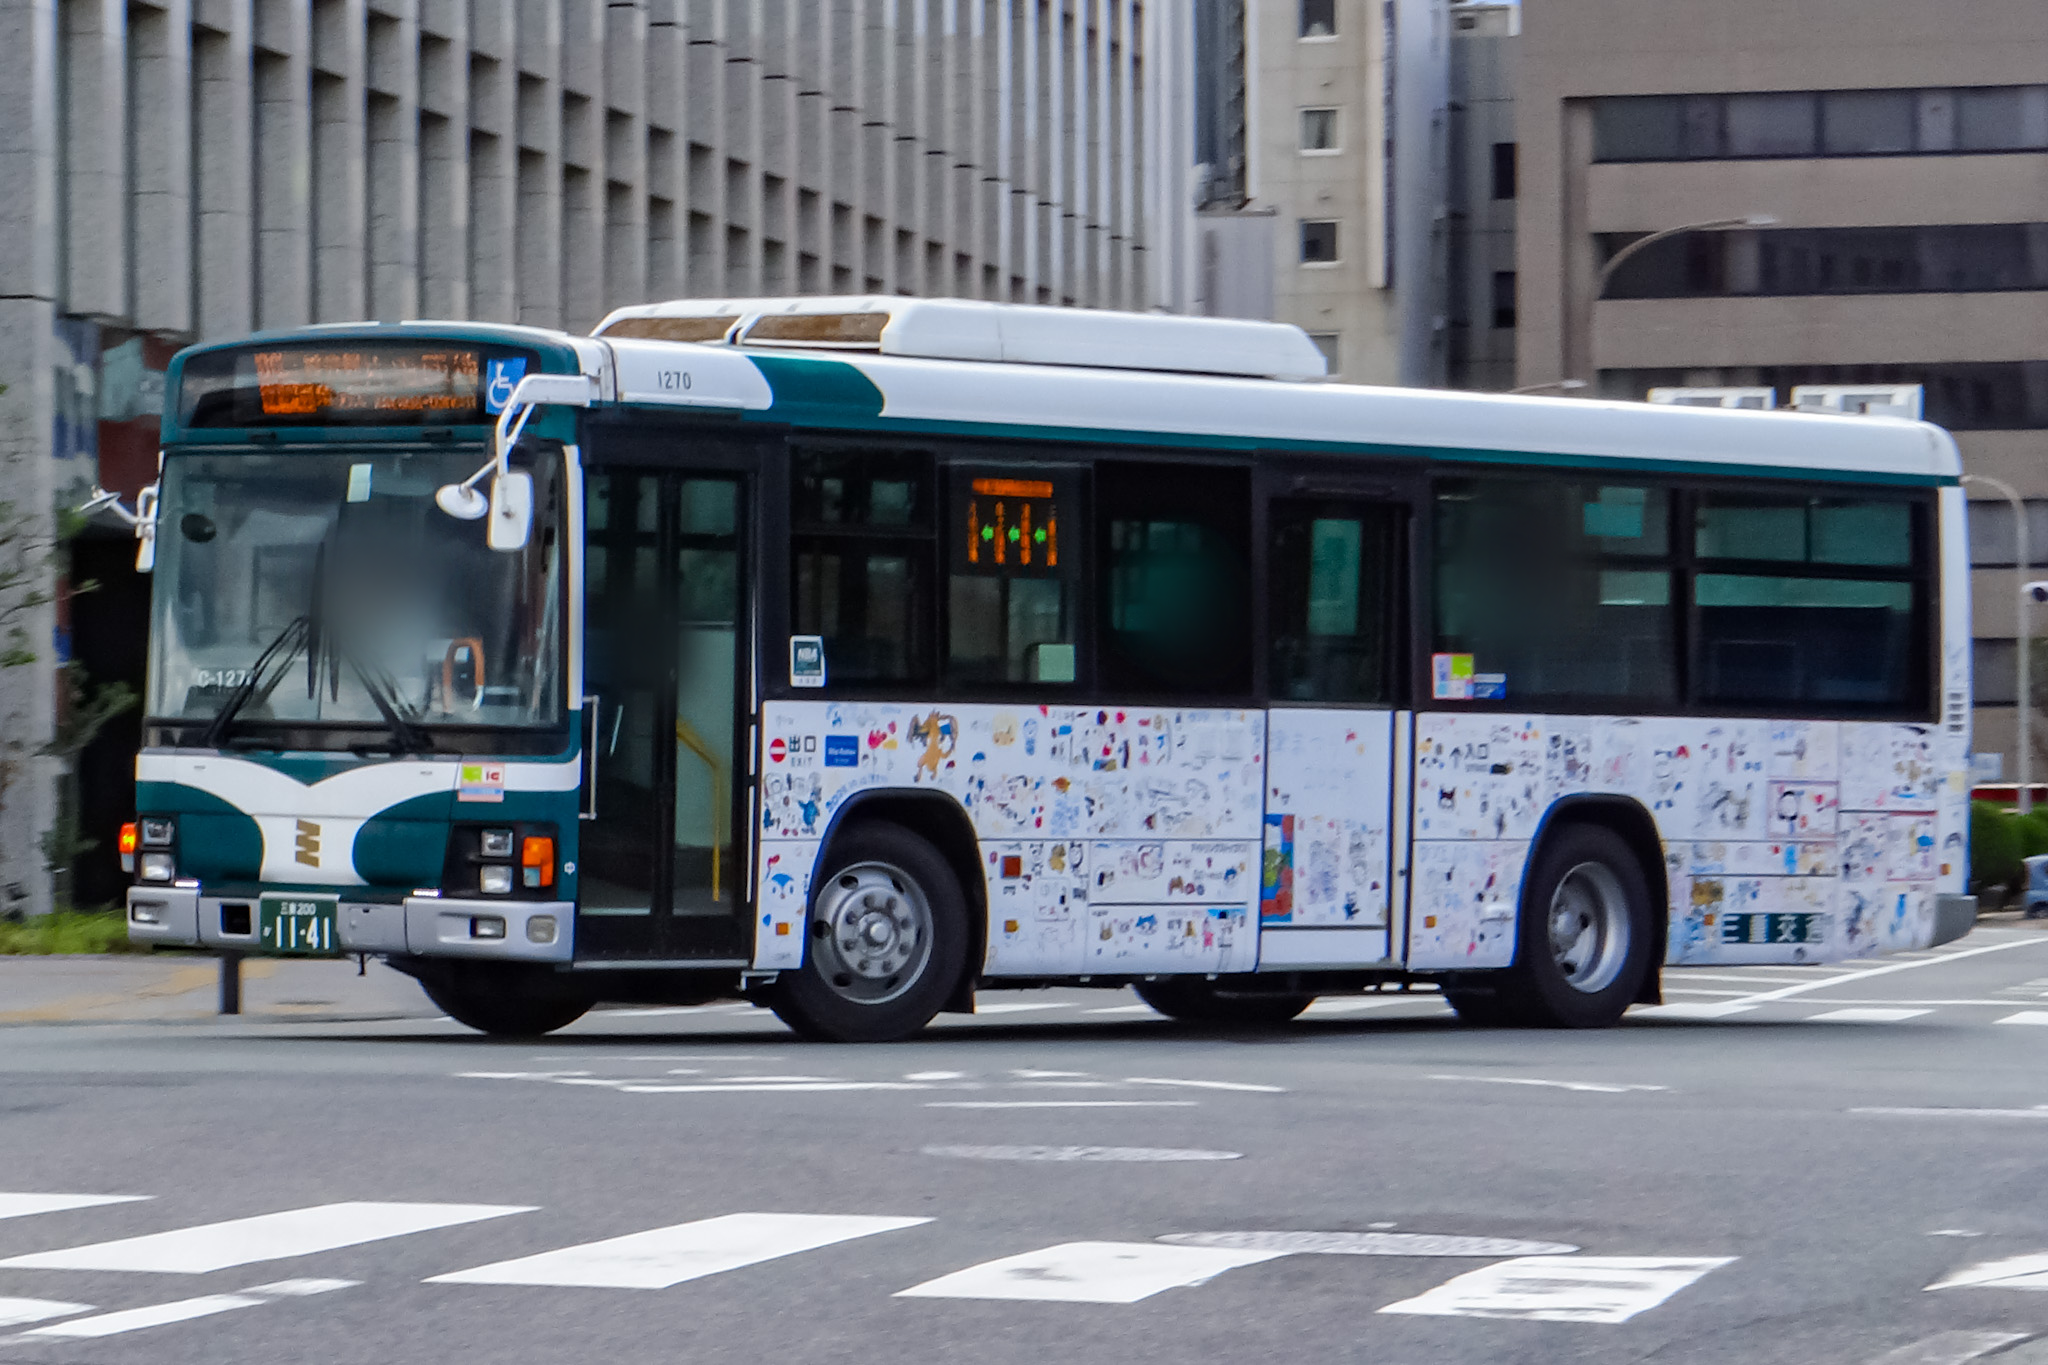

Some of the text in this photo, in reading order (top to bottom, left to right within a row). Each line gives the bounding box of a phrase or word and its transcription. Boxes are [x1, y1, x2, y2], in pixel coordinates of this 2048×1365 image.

[657, 371, 692, 390] 1270
[789, 734, 817, 753] 出口
[1464, 743, 1489, 760] 入口
